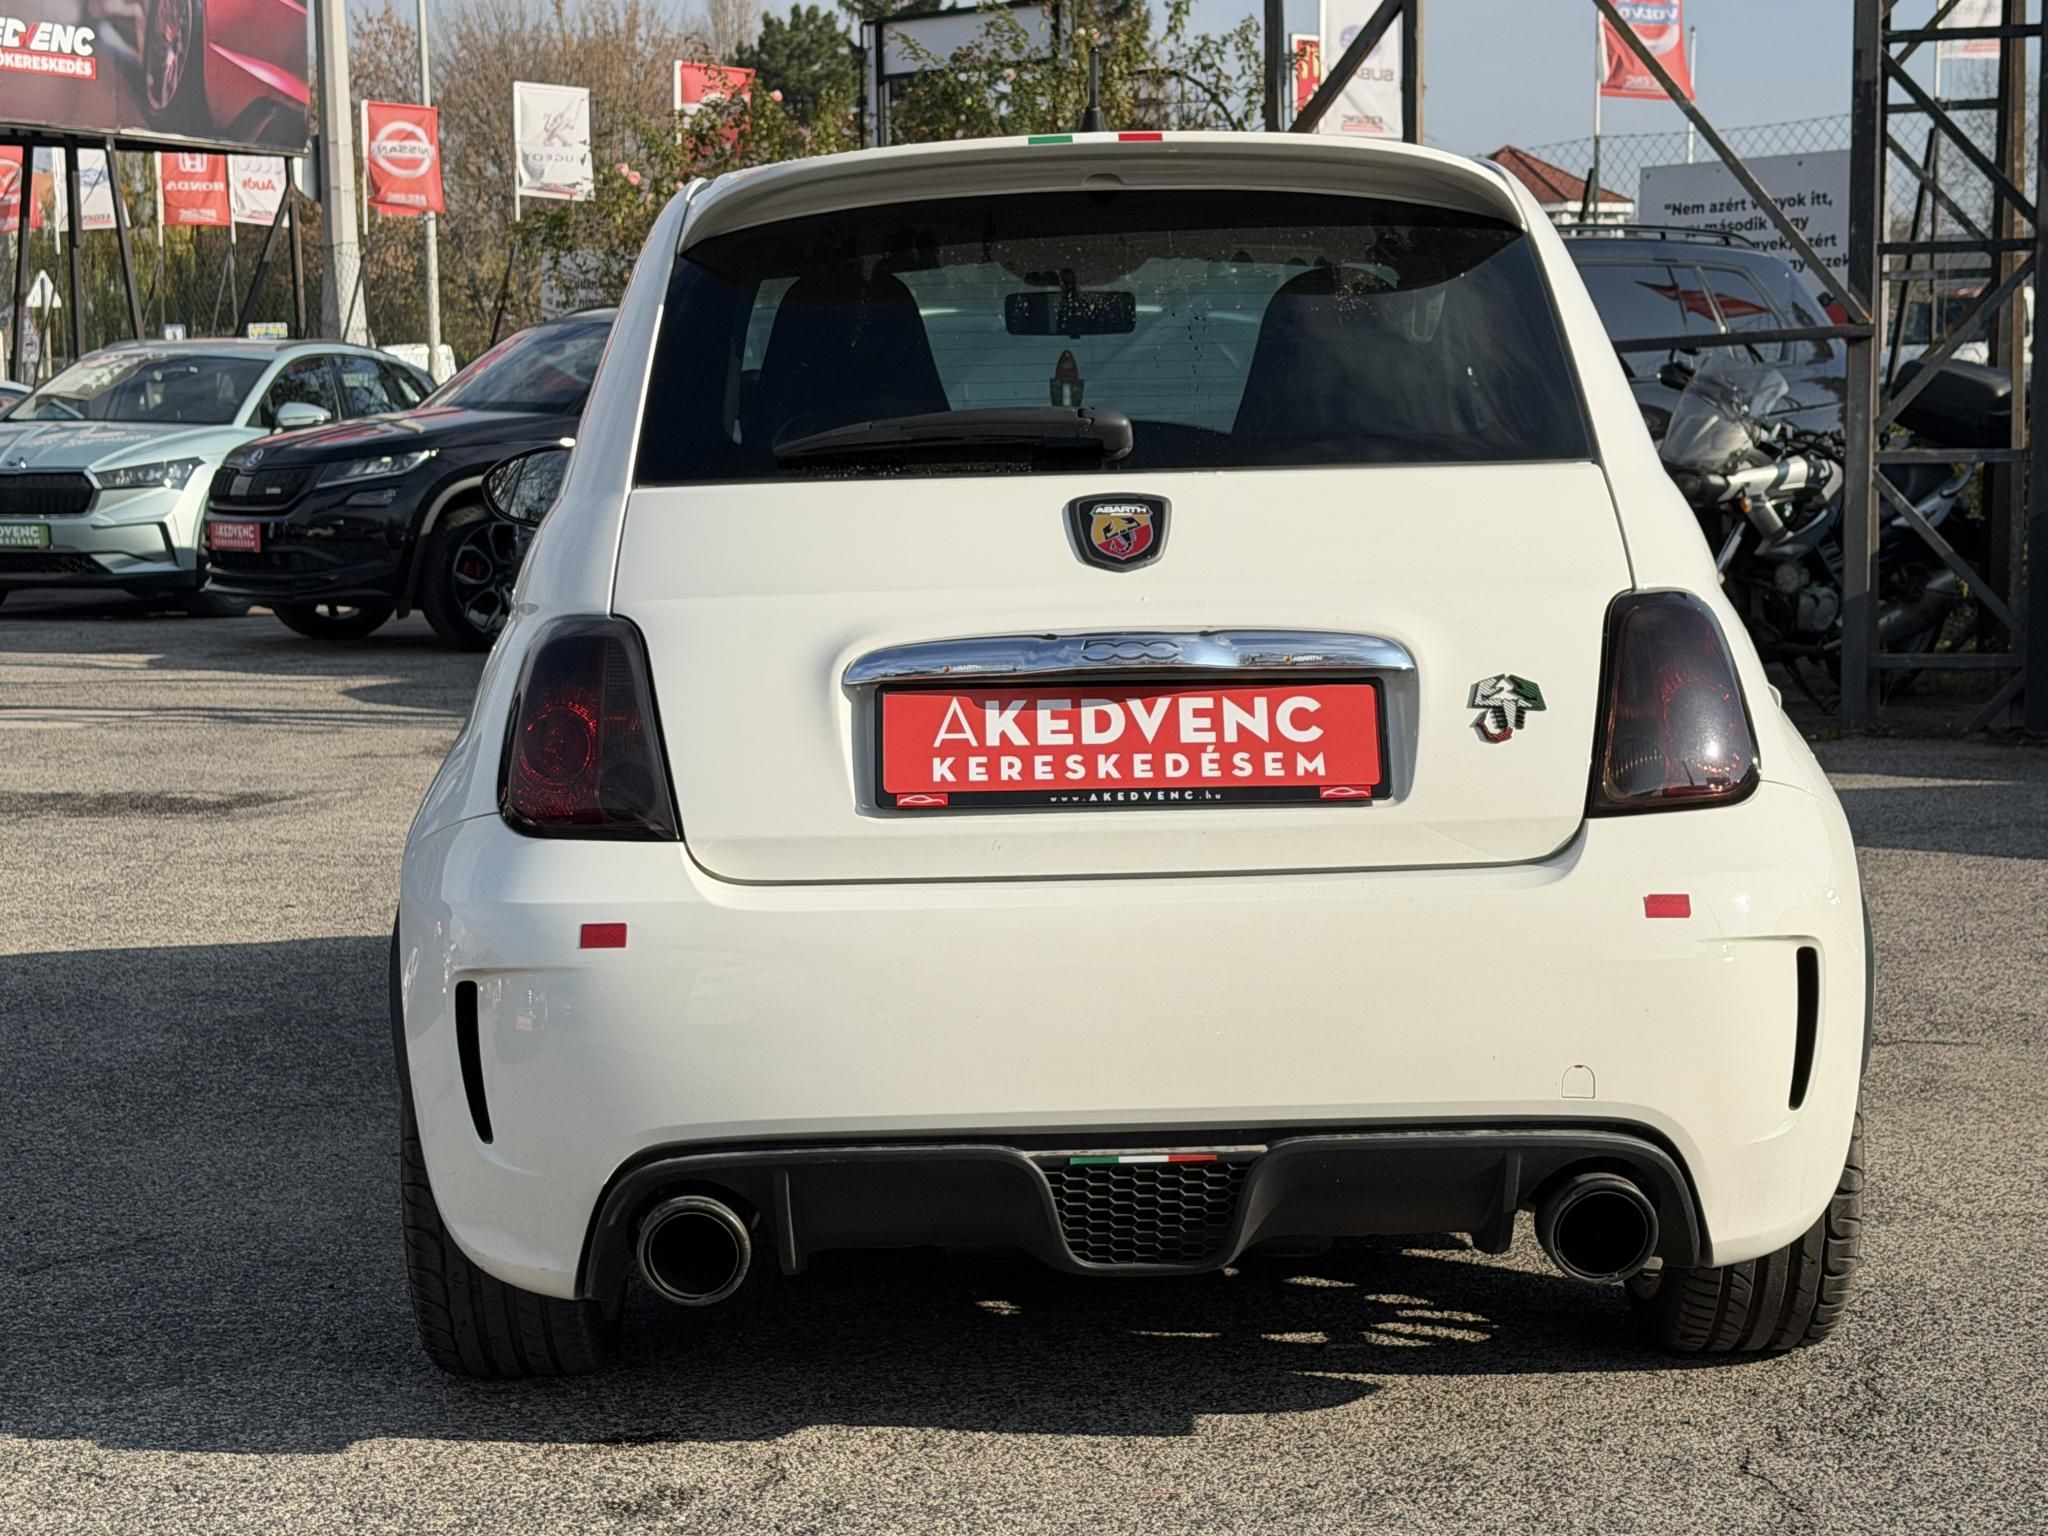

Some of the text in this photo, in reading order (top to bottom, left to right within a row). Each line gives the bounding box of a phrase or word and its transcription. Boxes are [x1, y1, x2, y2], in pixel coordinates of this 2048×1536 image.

[1710, 197, 1747, 213] azért
[1811, 190, 1833, 207] itt,
[1095, 505, 1147, 514] ABARTH
[1081, 638, 1181, 662] 500
[952, 664, 982, 672] ABARTH
[932, 694, 1325, 748] AKEDVENC
[932, 745, 1327, 783] KERESKEDÉSEM
